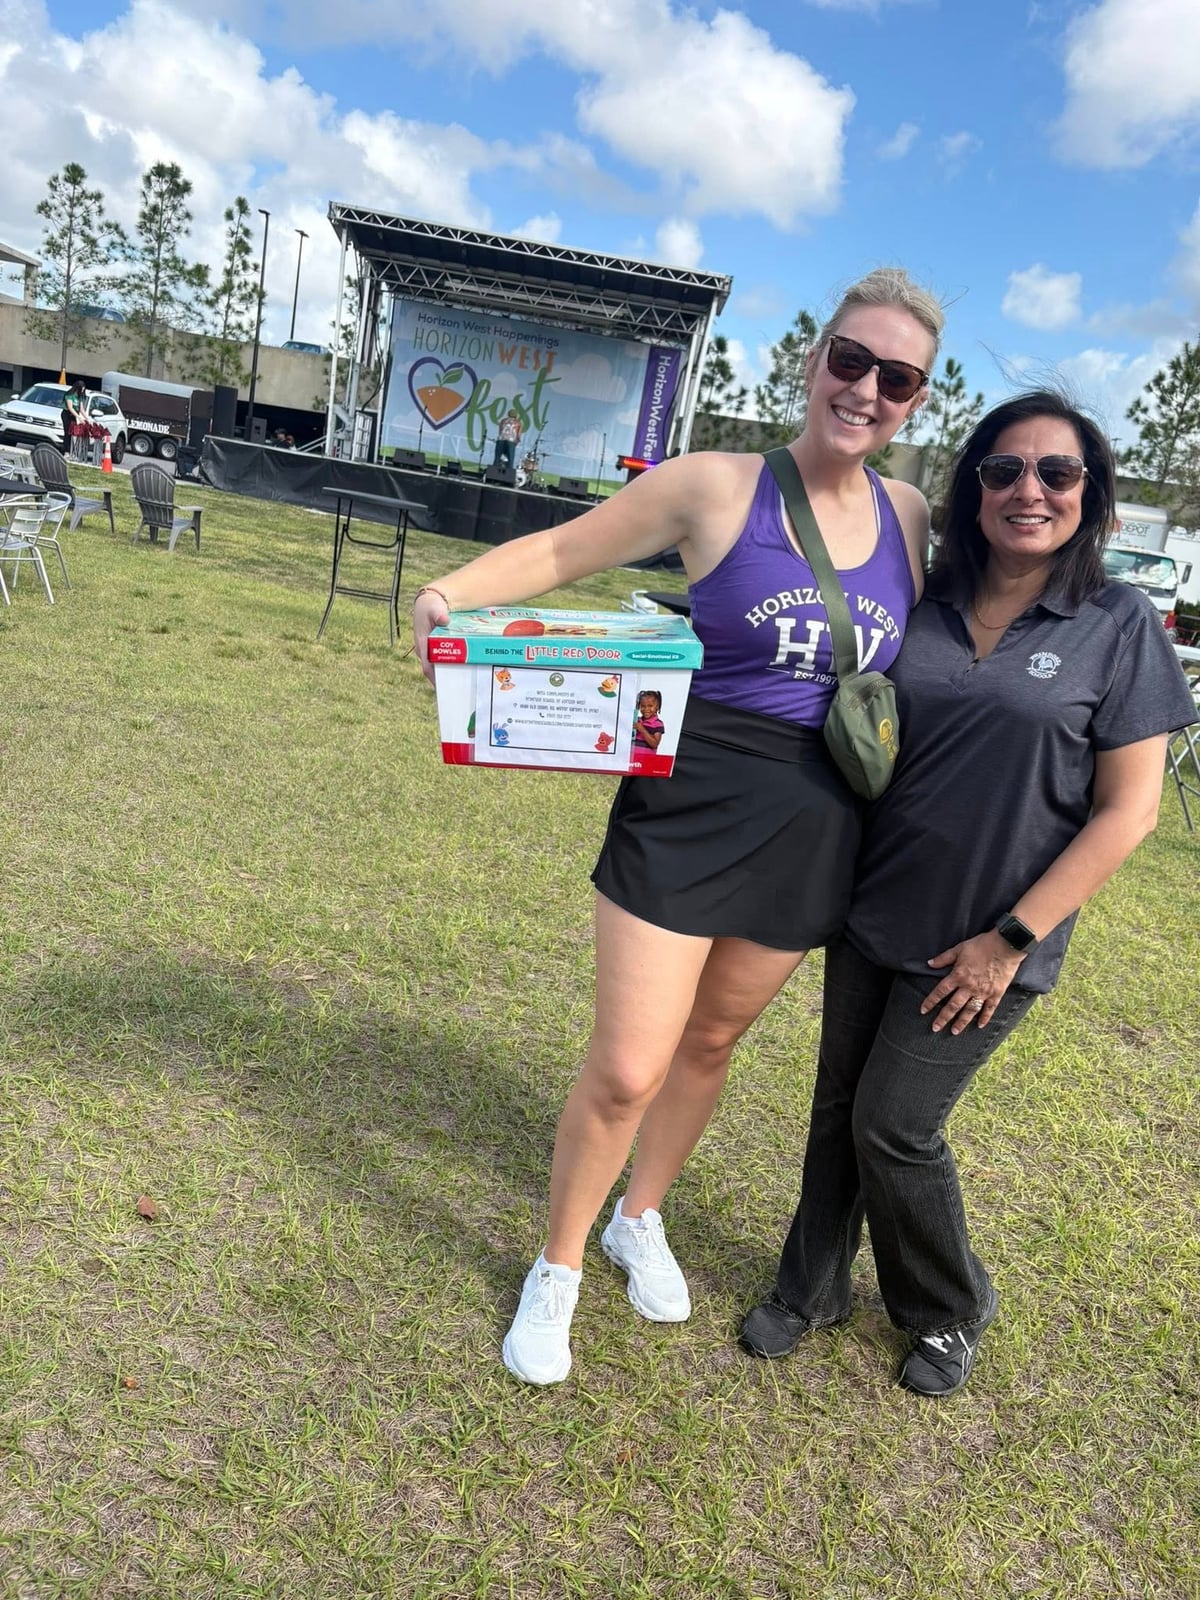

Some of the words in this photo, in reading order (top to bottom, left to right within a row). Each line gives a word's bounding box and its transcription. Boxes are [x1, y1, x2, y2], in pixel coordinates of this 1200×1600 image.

[413, 327, 494, 362] HORIZON
[497, 342, 559, 374] WEST
[417, 312, 460, 329] Horizon
[463, 320, 491, 335] West
[493, 325, 560, 349] Happenings
[125, 418, 170, 435] LEMONADE
[465, 367, 562, 452] fest
[643, 355, 672, 459] HorizonWestFes
[745, 587, 849, 629] HORIZ
[857, 595, 900, 642] WEST
[525, 644, 559, 662] LITTLE
[562, 647, 584, 658] RED
[586, 646, 621, 661] DOOR
[814, 673, 838, 686] 1997
